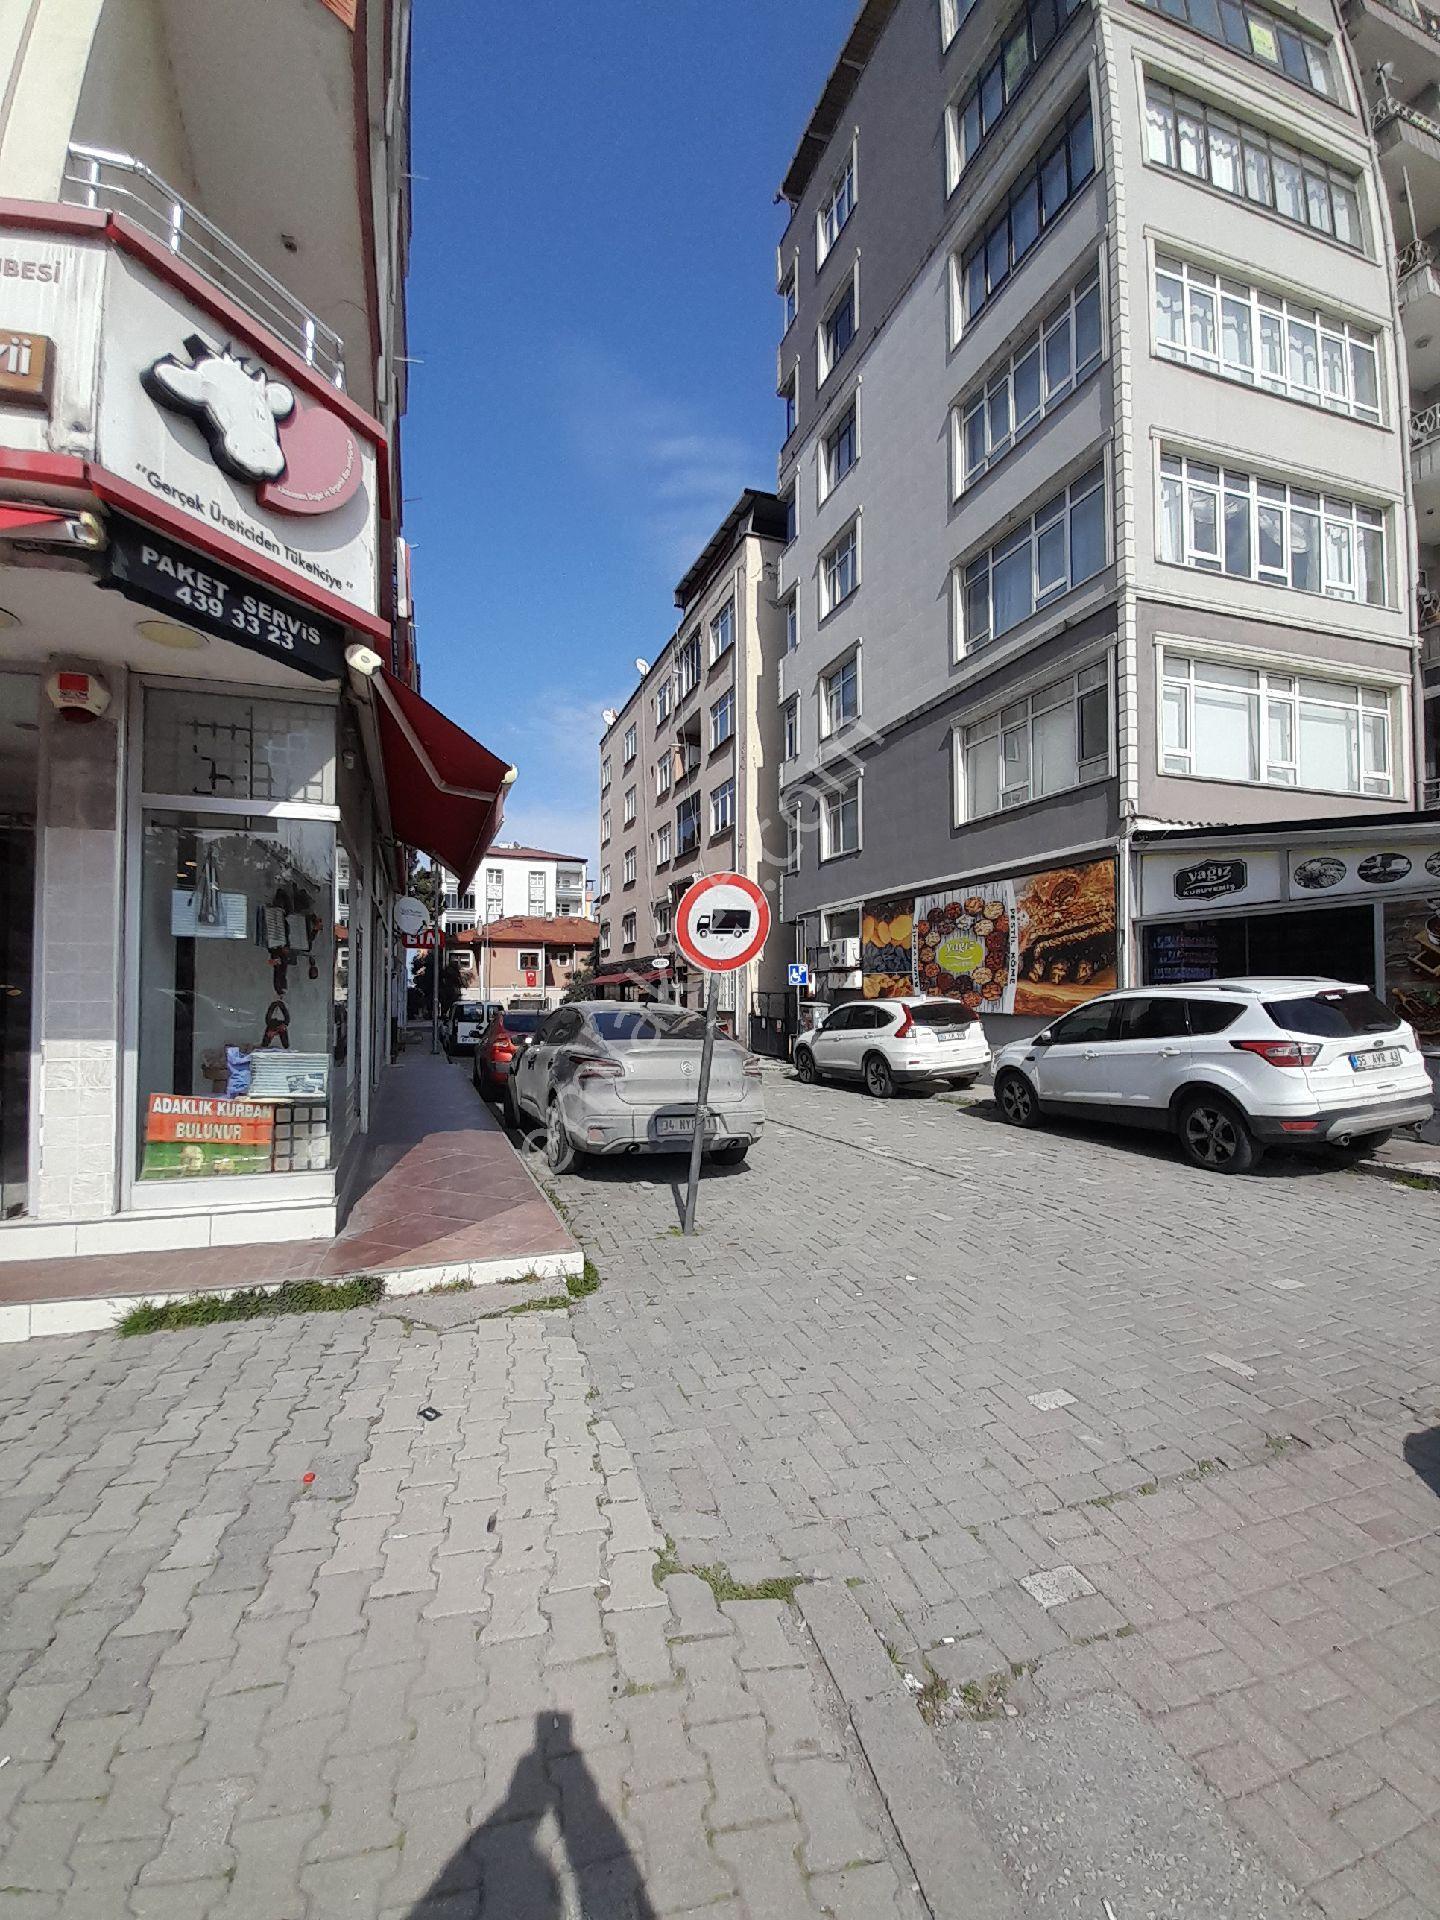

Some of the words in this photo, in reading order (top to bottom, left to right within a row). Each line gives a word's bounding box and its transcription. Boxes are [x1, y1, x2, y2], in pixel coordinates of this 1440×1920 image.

[0, 258, 61, 284] BESİ
[210, 500, 281, 556] Üreticiden
[142, 545, 230, 600] PAKET
[176, 586, 224, 619] 439
[231, 609, 260, 635] 33
[267, 624, 295, 650] 23
[1186, 865, 1232, 885] yağız
[152, 1098, 214, 1115] ADAKLIK
[216, 1101, 272, 1118] KURBAN
[175, 1123, 242, 1139] BULUNUR
